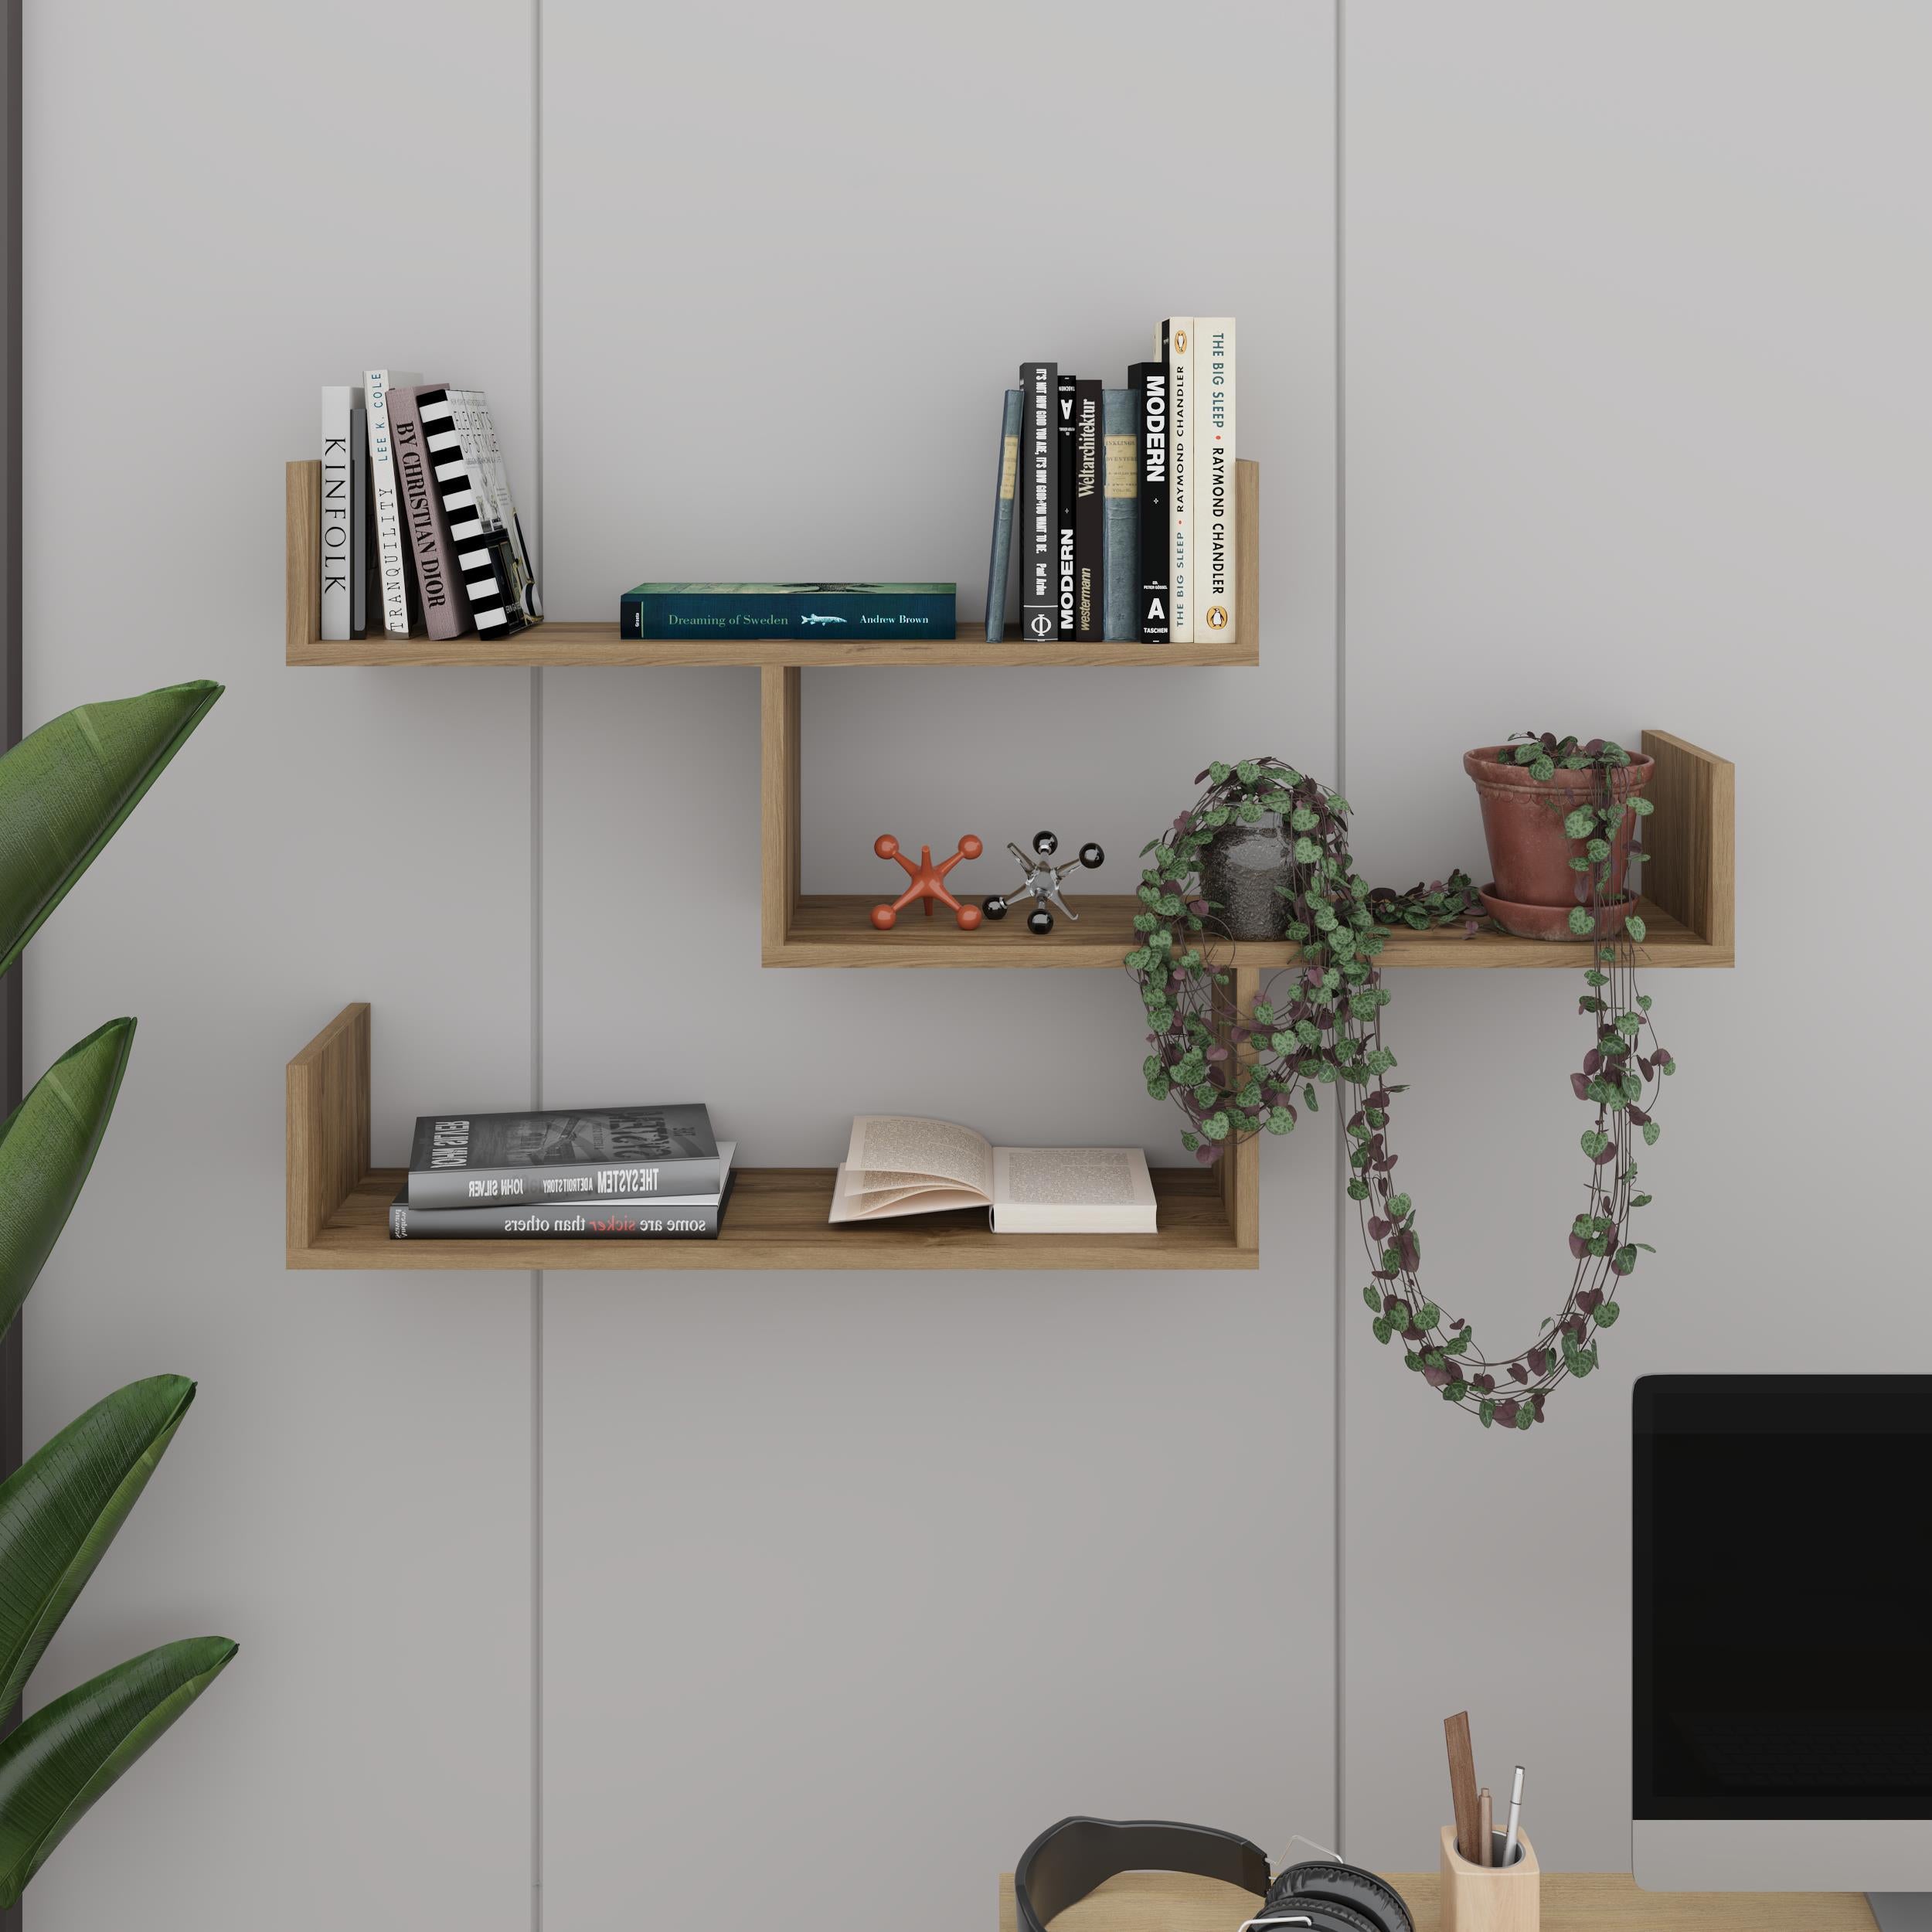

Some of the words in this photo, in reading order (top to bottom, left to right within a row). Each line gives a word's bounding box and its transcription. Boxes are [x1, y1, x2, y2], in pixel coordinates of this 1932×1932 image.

[1213, 332, 1224, 356] THE
[1036, 368, 1047, 380] IT'S
[1212, 362, 1224, 386] BIG
[371, 373, 383, 408] COLE
[1036, 382, 1047, 393] NOT
[1036, 396, 1047, 409] HOW
[1060, 399, 1073, 420] A
[1212, 392, 1224, 428] SLEEP
[375, 417, 386, 429] K.
[1036, 410, 1047, 426] GOOD
[1146, 376, 1165, 482] MODERN
[396, 420, 418, 447] BY
[1036, 427, 1047, 440] YOU
[377, 437, 388, 461] LEE
[1034, 440, 1047, 455] ARE,
[1078, 399, 1096, 498] Weltarchitektur
[1036, 457, 1047, 468] IT'S
[1036, 469, 1047, 484] HOW
[1212, 447, 1224, 517] RAYMOND
[402, 452, 437, 554] CHRISTIAN
[324, 438, 346, 594] KINFOLK
[1036, 515, 1047, 533] WANT
[1036, 534, 1047, 543] TO
[1036, 543, 1047, 554] BE.
[379, 488, 404, 631] TRANQUILITY
[1212, 523, 1224, 594] CHANDLER
[1036, 563, 1047, 577] Paul
[1060, 529, 1074, 630] MODERN
[420, 558, 446, 609] DIOR
[1036, 578, 1047, 596] Arden
[1079, 567, 1091, 631] westermann
[1148, 597, 1165, 620] A
[668, 614, 726, 628] Dreaming
[729, 614, 741, 625] of
[743, 614, 789, 625] Sweden
[859, 614, 896, 624] Andrew
[899, 614, 929, 624] Brown
